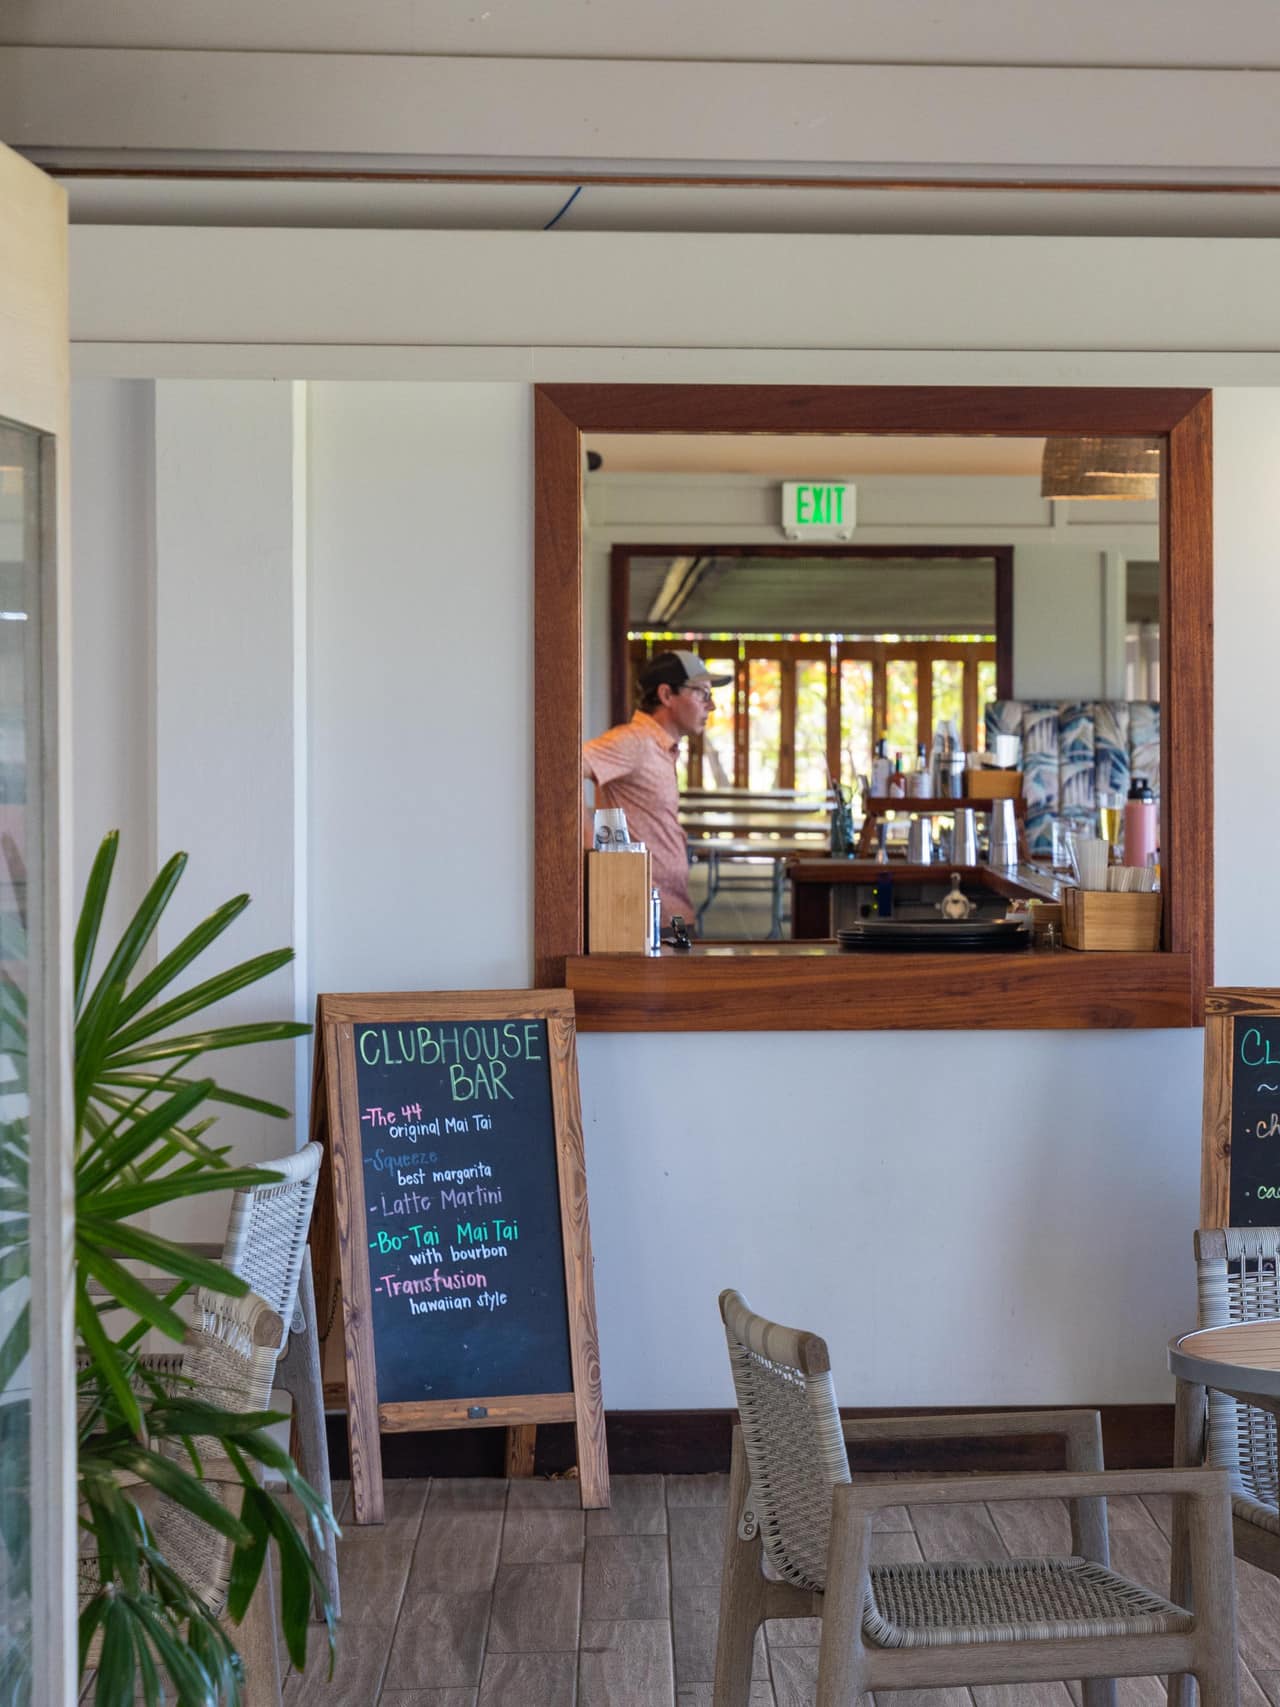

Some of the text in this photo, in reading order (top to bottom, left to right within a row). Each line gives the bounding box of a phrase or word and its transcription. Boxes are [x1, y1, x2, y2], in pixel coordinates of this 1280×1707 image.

[796, 486, 846, 525] EXIT
[360, 1023, 542, 1066] CLUBHOUSE
[450, 1060, 514, 1101] BAR
[401, 1103, 422, 1124] 44
[389, 1114, 492, 1143] original Mai Tai
[397, 1161, 492, 1186] best margarita
[440, 1184, 502, 1210] Martini
[456, 1222, 488, 1245] Mai
[492, 1219, 519, 1242] Tai
[409, 1243, 508, 1266] with bourbon
[409, 1291, 508, 1315] hawaiian style
